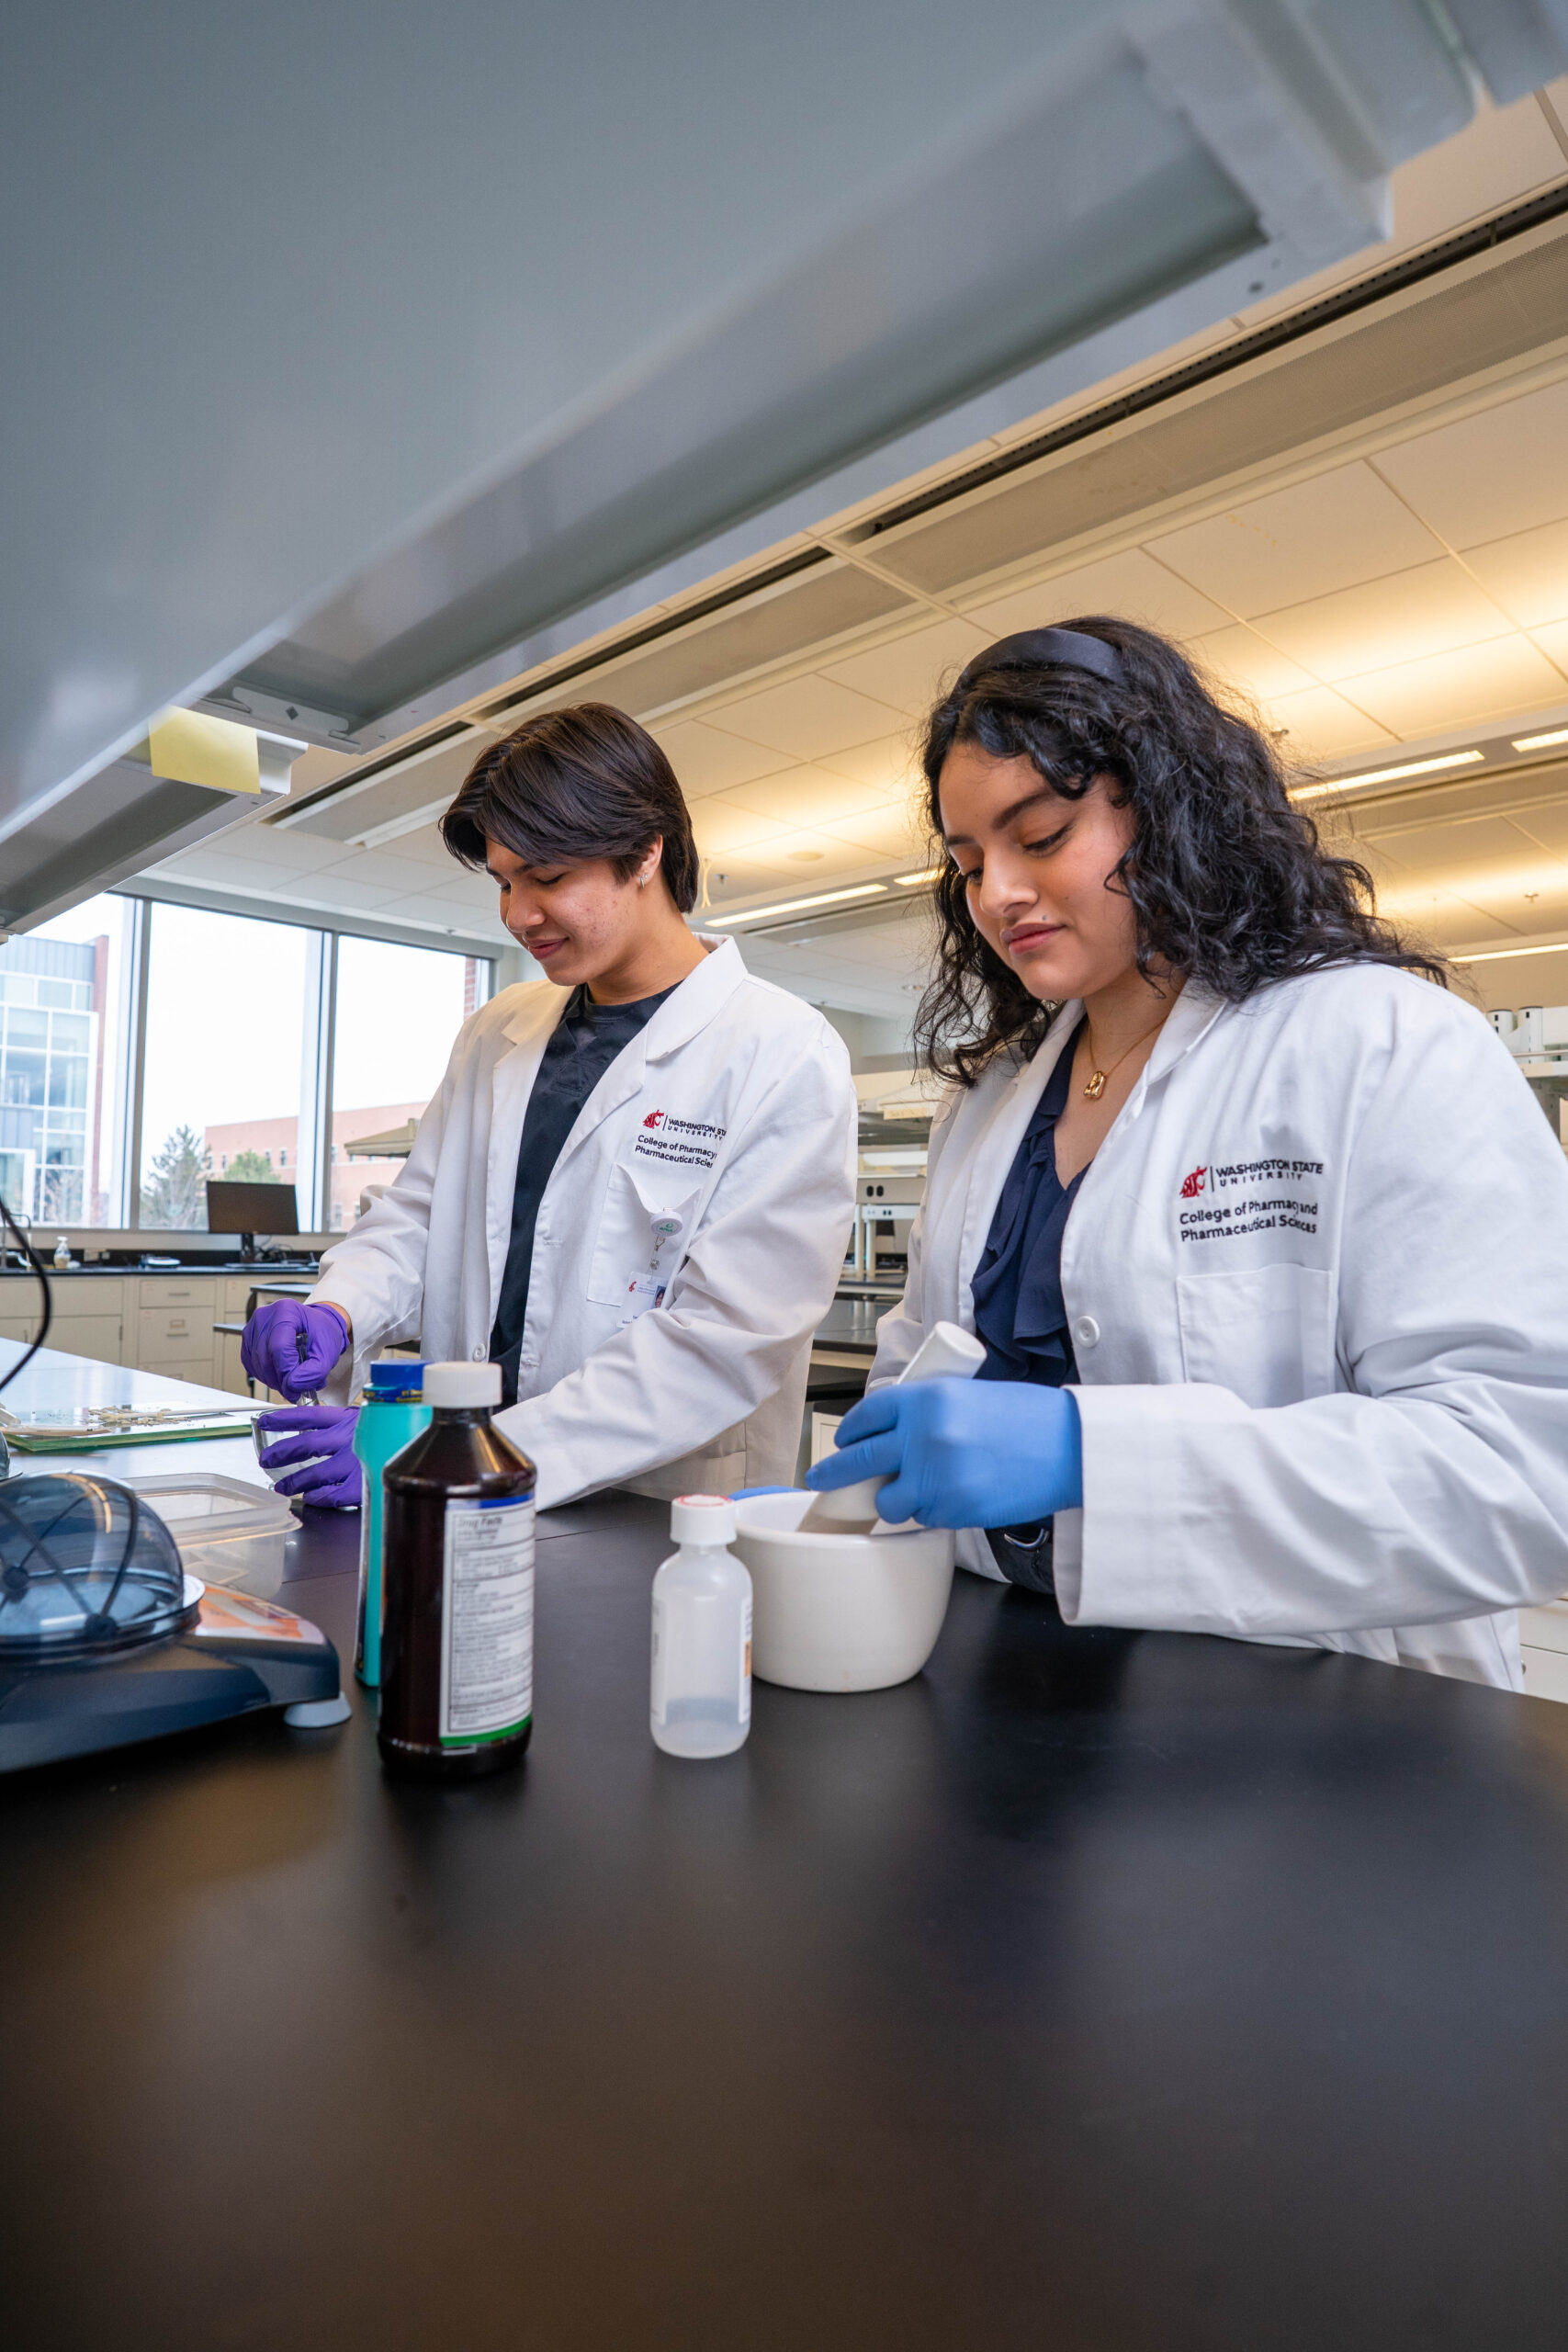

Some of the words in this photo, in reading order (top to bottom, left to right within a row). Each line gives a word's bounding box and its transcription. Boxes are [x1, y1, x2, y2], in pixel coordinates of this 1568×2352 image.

[668, 1125, 723, 1140] UNIVERSITY
[669, 1118, 716, 1133] WASHINGTON
[635, 1145, 694, 1164] Pharmaceutical
[638, 1135, 668, 1148] College
[679, 1145, 715, 1159] Pharmacy
[1215, 1159, 1290, 1177] WASHINGTON
[1292, 1161, 1324, 1174] STATE
[1219, 1171, 1303, 1187] UNIVERSITY
[1179, 1207, 1231, 1225] College
[1235, 1202, 1248, 1216] of
[1181, 1216, 1276, 1242] Pharmaceutical
